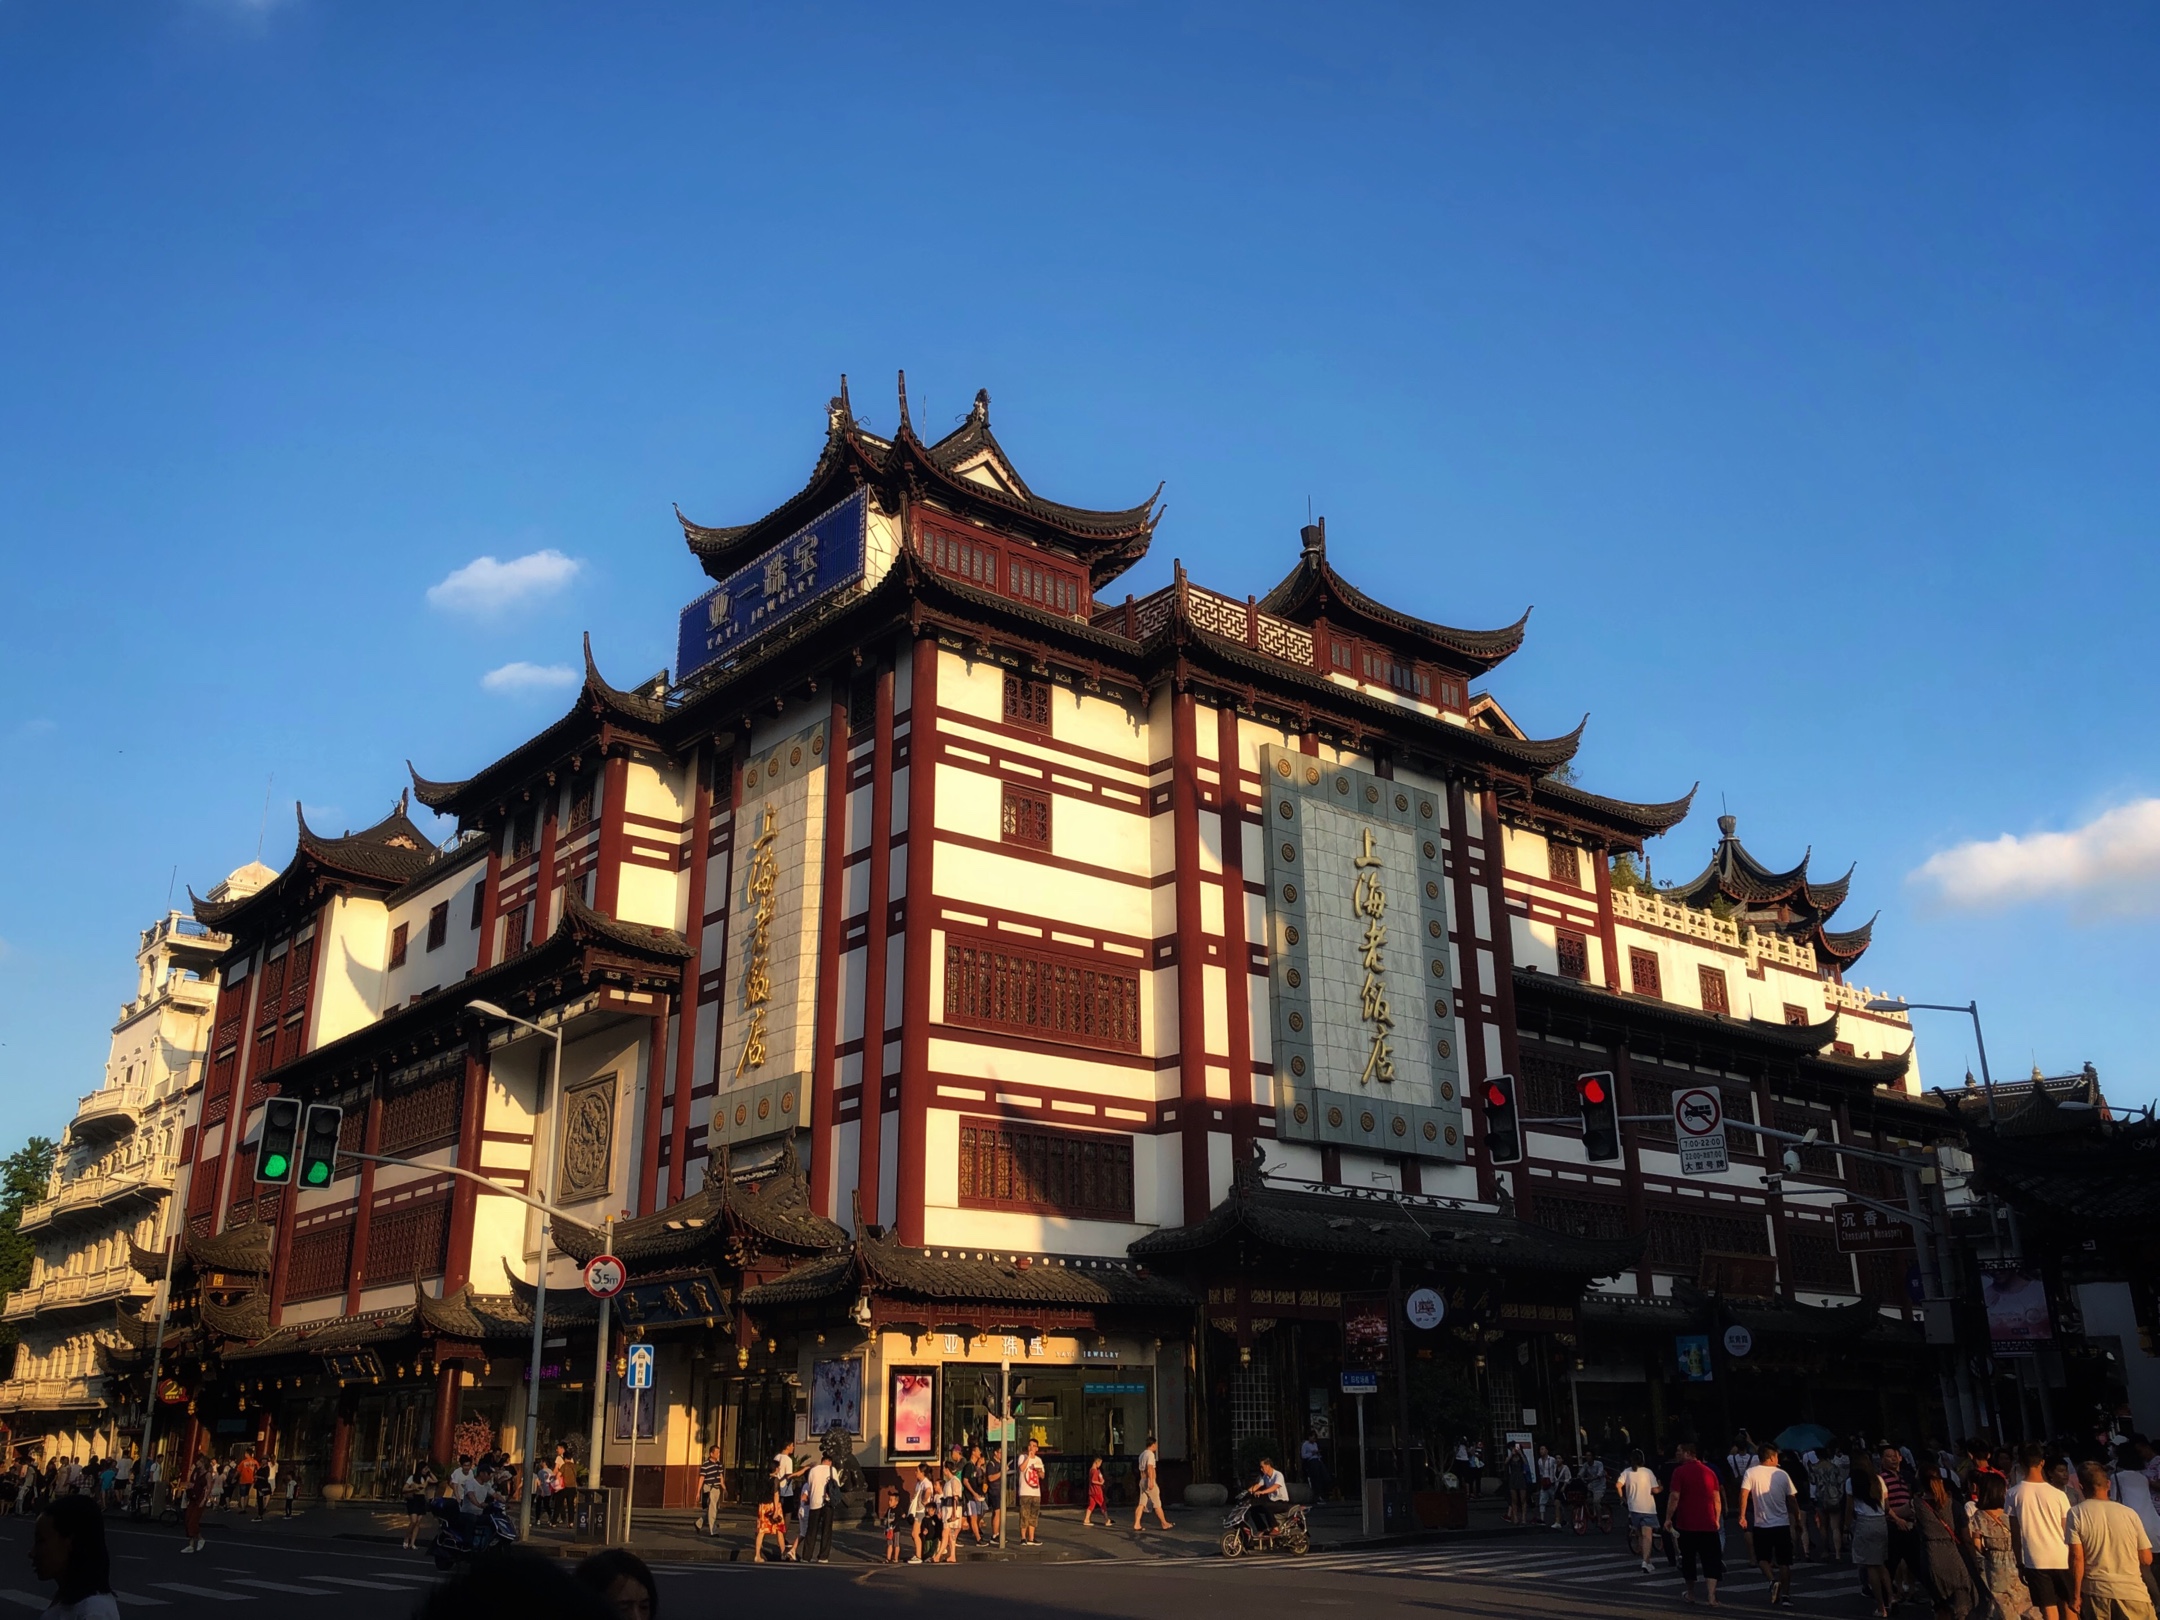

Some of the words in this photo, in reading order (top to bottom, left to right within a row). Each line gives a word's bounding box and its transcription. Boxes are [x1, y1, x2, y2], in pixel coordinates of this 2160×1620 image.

[706, 621, 740, 650] YAYI
[751, 573, 816, 625] JEWELRY
[1353, 826, 1396, 1085] 上海老饭店
[1685, 1160, 1725, 1171] 大型号牌
[592, 1268, 618, 1285] 3.5m
[943, 1334, 1045, 1356] 亚一珠宝
